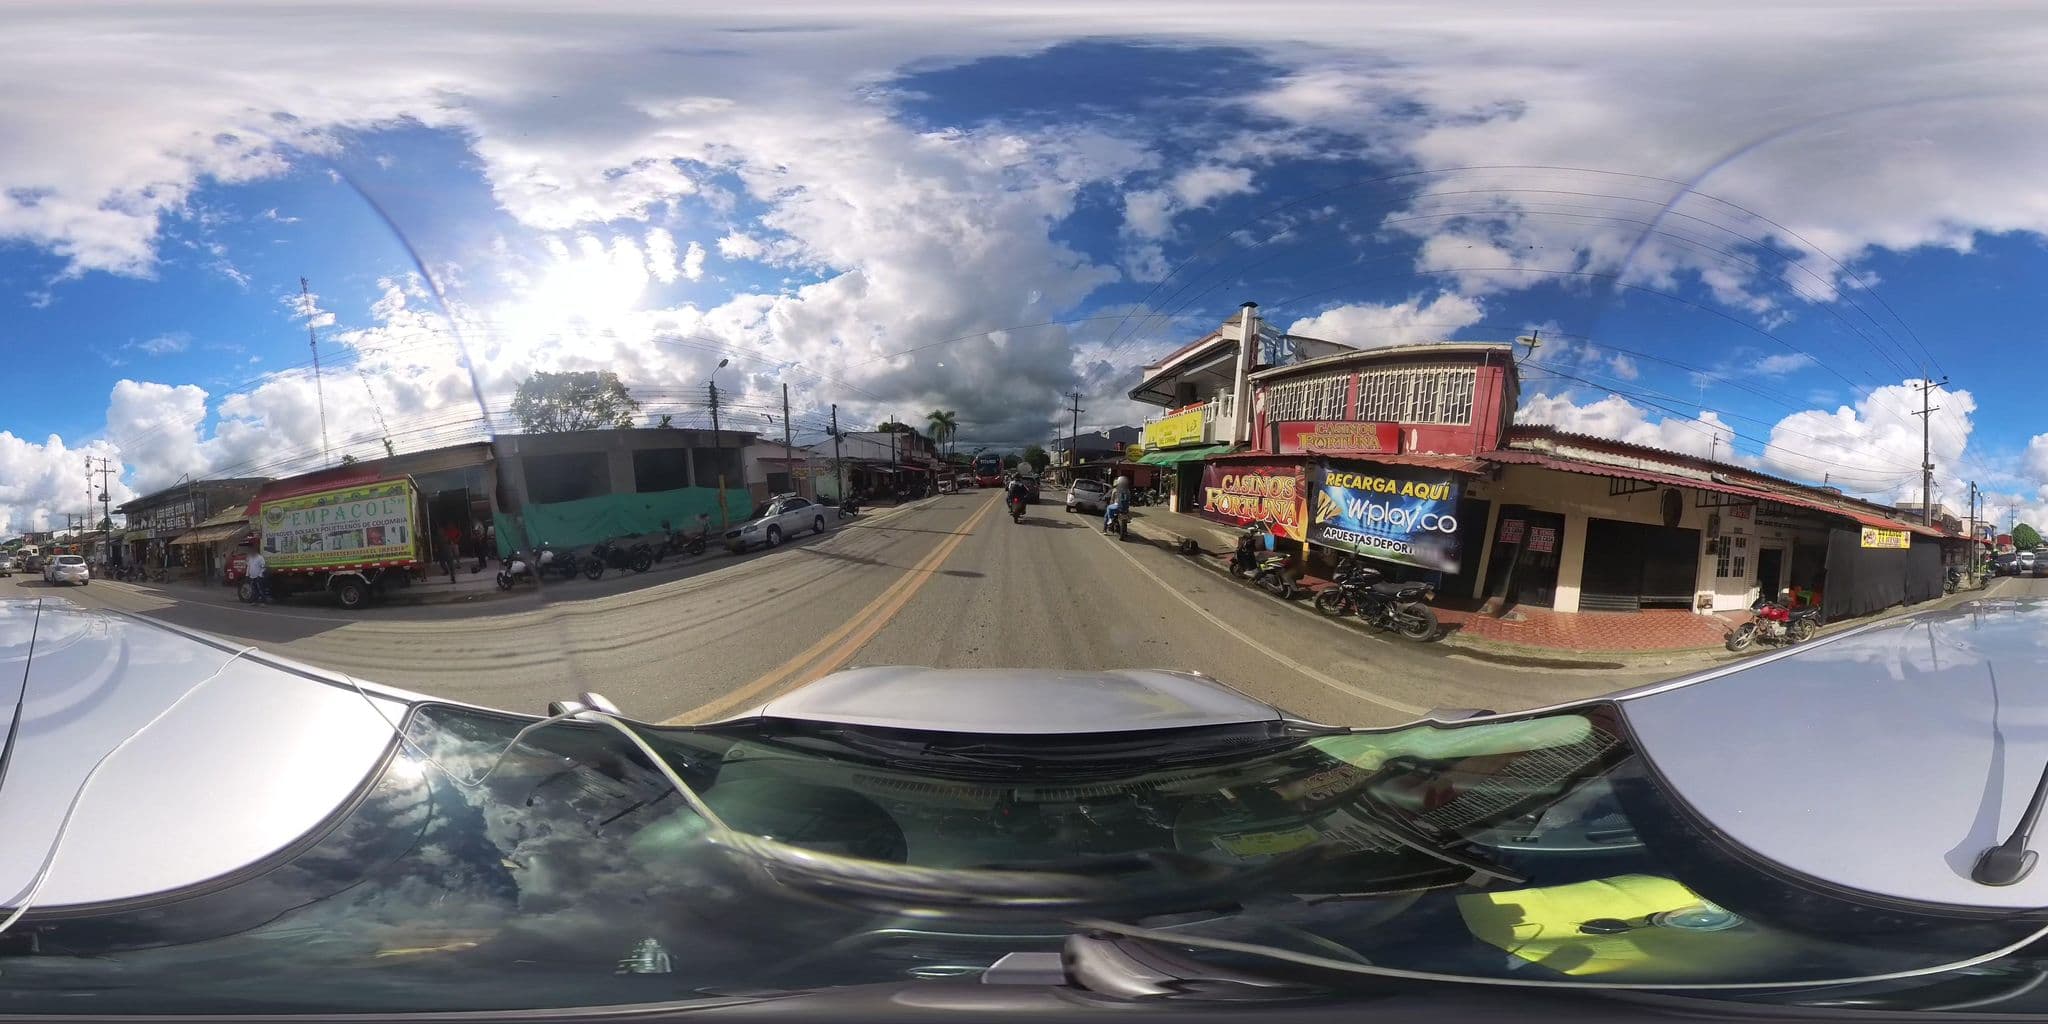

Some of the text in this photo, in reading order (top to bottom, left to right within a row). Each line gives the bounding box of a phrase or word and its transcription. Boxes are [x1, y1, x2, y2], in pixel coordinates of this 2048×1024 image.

[1315, 423, 1377, 435] CASINOS
[1297, 432, 1382, 450] FORTUNA
[1222, 474, 1296, 499] CASINOS
[1325, 472, 1450, 501] RECARGA AQUÍ
[1203, 487, 1299, 528] FORTUNA
[1347, 497, 1458, 534] Wplay.co
[362, 521, 371, 529] DE
[1323, 527, 1372, 546] APUESTAS
